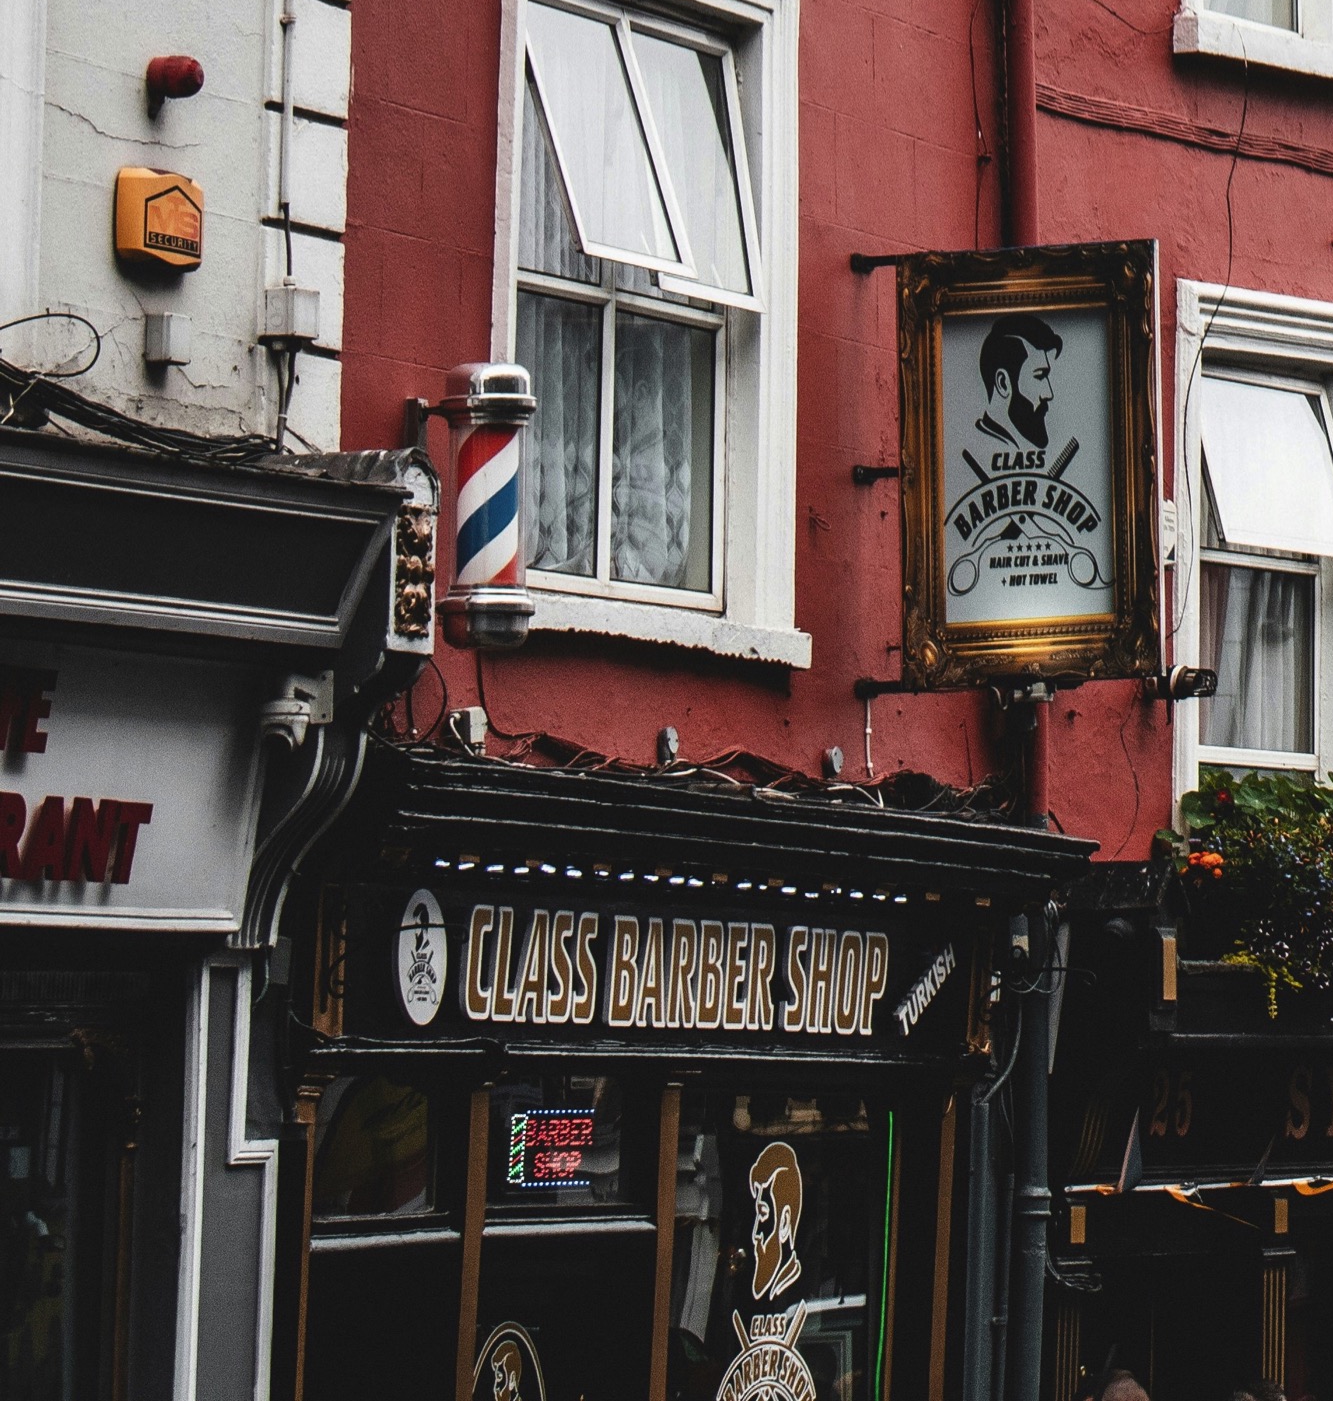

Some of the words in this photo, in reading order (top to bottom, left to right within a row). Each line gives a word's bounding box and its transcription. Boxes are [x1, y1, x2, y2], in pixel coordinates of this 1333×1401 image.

[150, 232, 198, 251] SECURITY
[991, 450, 1046, 471] CLASS
[953, 479, 1038, 542] BARBER
[1041, 483, 1099, 534] SHOP
[989, 556, 1012, 569] HAIR
[1013, 555, 1030, 567] CUT
[1032, 554, 1039, 566] &
[1041, 553, 1070, 566] SHAVE
[1009, 574, 1027, 587] HOT
[1029, 572, 1058, 585] TOWEL
[463, 904, 600, 1024] CLASS
[605, 914, 776, 1031] BARBER
[782, 925, 889, 1036] SHOP
[897, 942, 956, 1036] TURKISH
[1149, 1067, 1193, 1137] 25
[525, 1118, 594, 1147] BARBER
[532, 1150, 582, 1179] SHOP
[749, 1313, 787, 1340] CLASS
